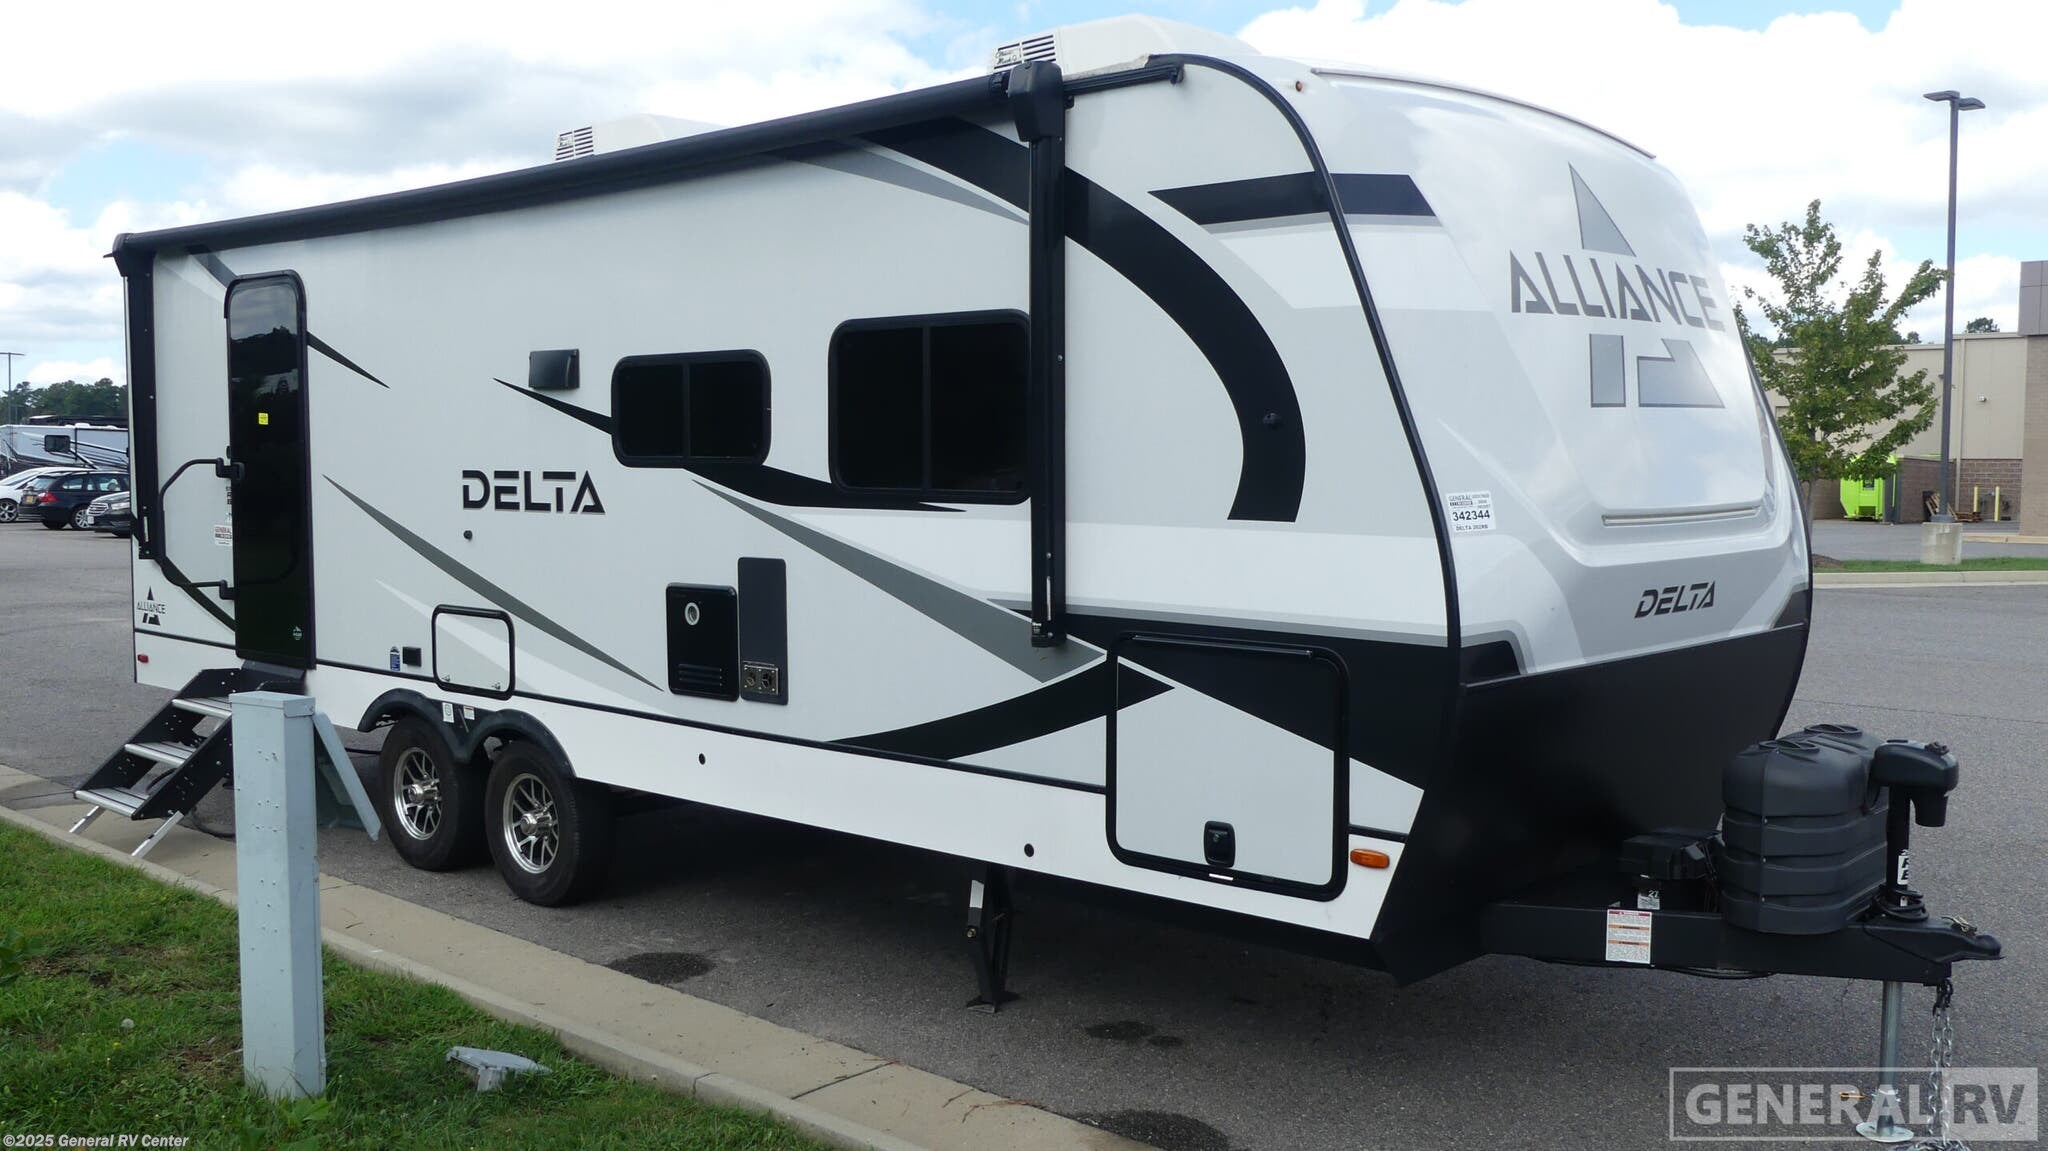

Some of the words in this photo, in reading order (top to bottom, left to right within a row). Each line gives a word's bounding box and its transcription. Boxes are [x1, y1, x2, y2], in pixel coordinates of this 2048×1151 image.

[1510, 250, 1725, 331] ALLIANCE
[462, 470, 606, 515] DELTA
[1452, 510, 1490, 521] 342344
[136, 601, 166, 615] ALLIANCE
[1634, 581, 1715, 619] DELTA
